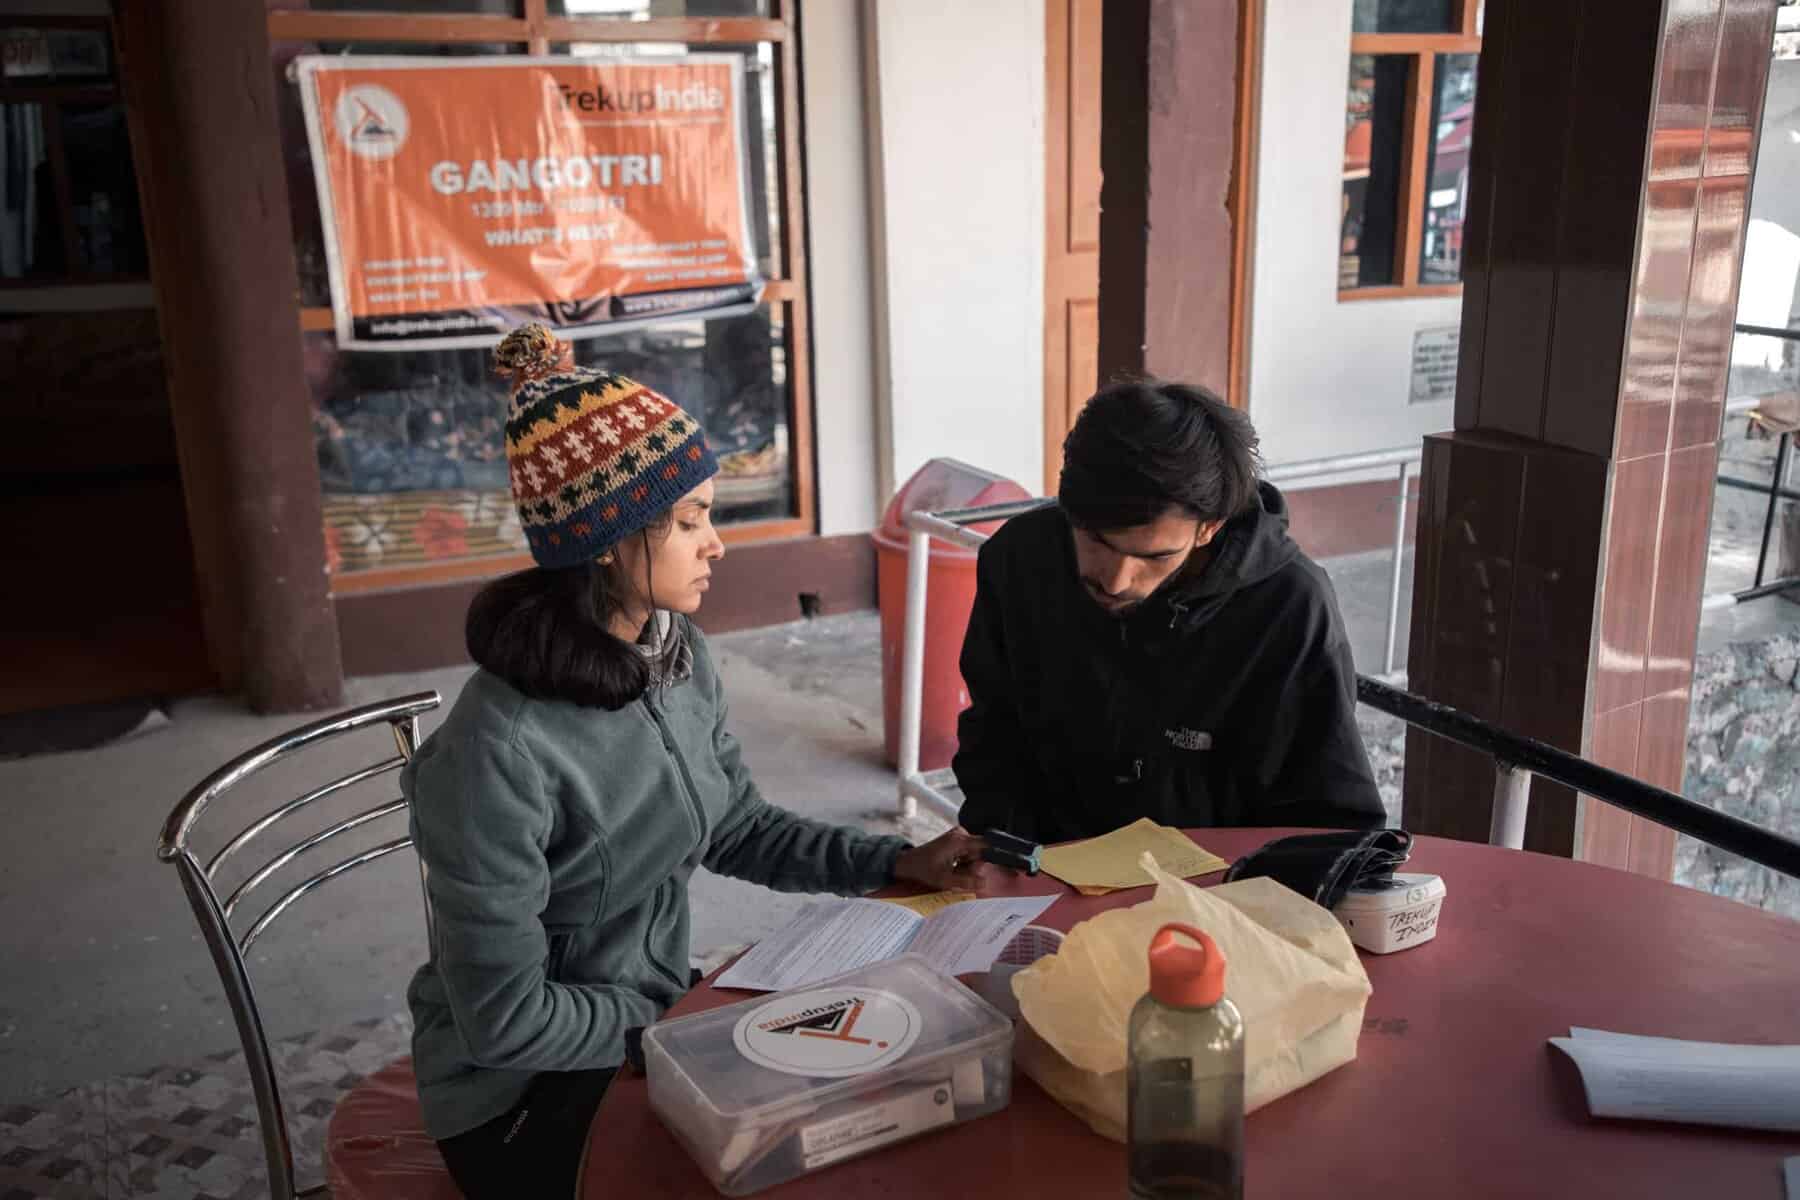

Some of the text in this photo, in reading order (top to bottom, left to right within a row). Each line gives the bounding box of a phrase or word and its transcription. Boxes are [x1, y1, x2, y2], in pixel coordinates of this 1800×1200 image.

[430, 154, 662, 195] GANGOTRI
[484, 223, 617, 247] WHAT'S NEXT
